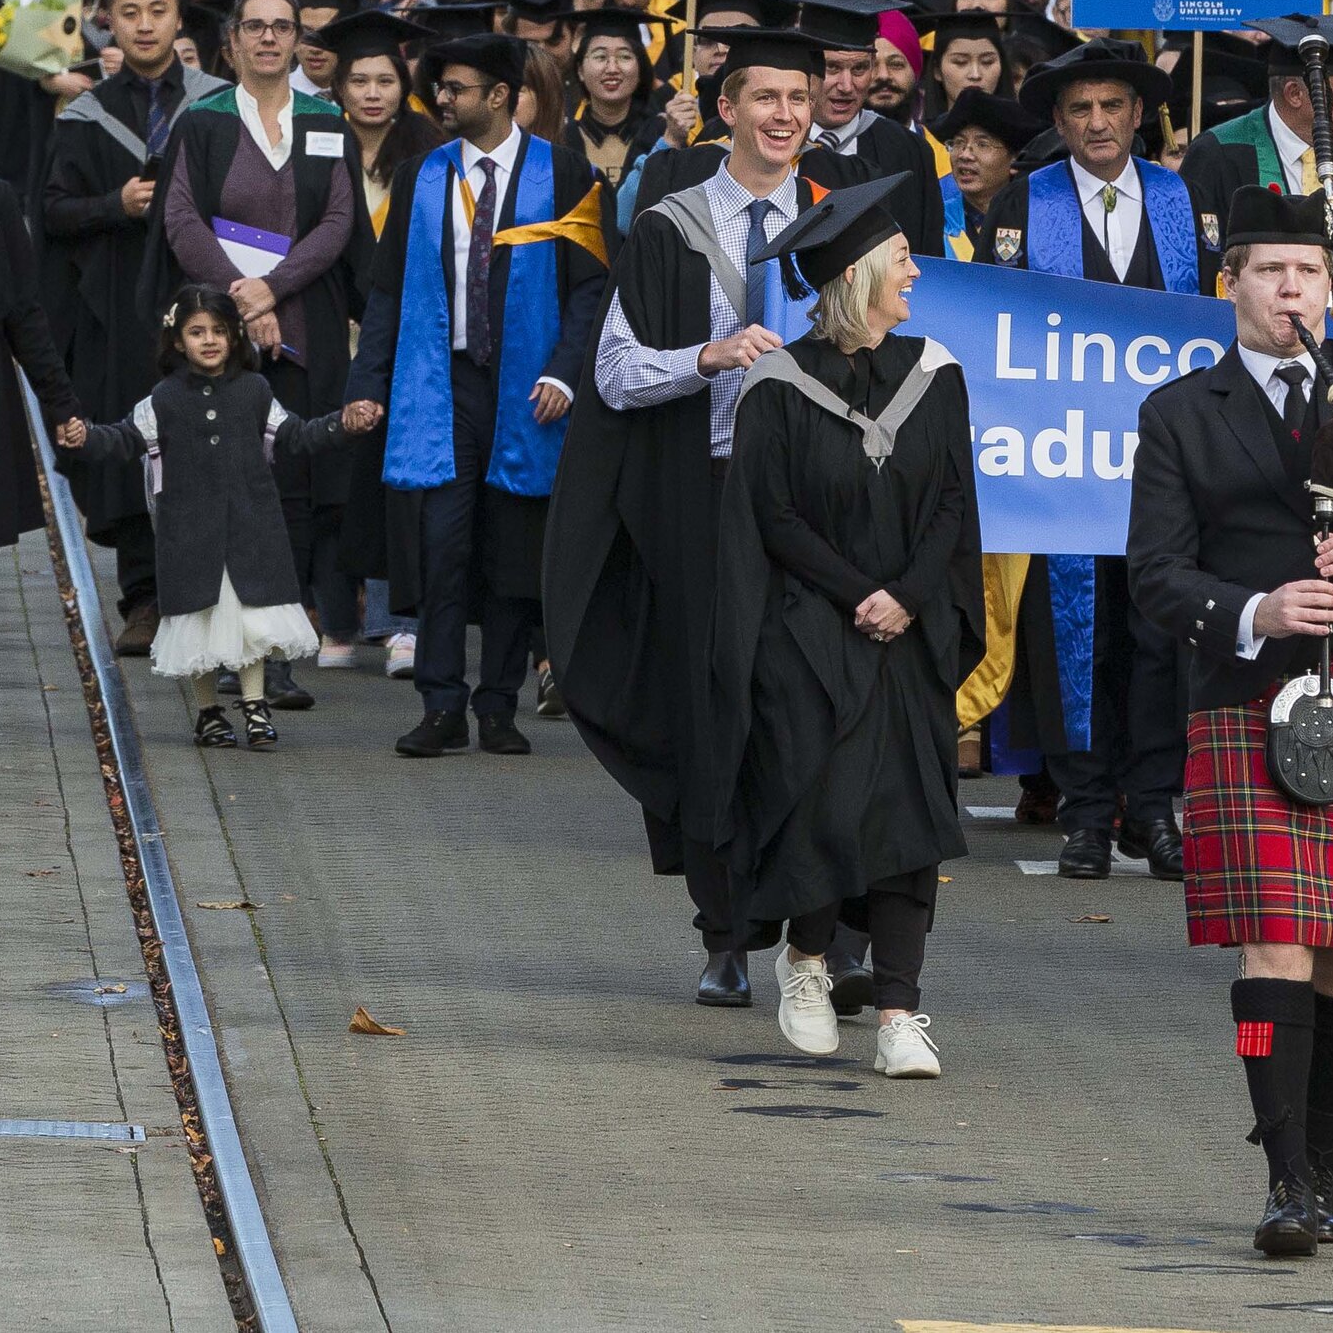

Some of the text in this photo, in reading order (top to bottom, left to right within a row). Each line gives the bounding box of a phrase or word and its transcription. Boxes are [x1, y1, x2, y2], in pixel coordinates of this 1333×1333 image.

[1179, 0, 1224, 8] LINCOLN
[1179, 7, 1243, 16] UNIVERSITY
[995, 312, 1226, 385] Linco
